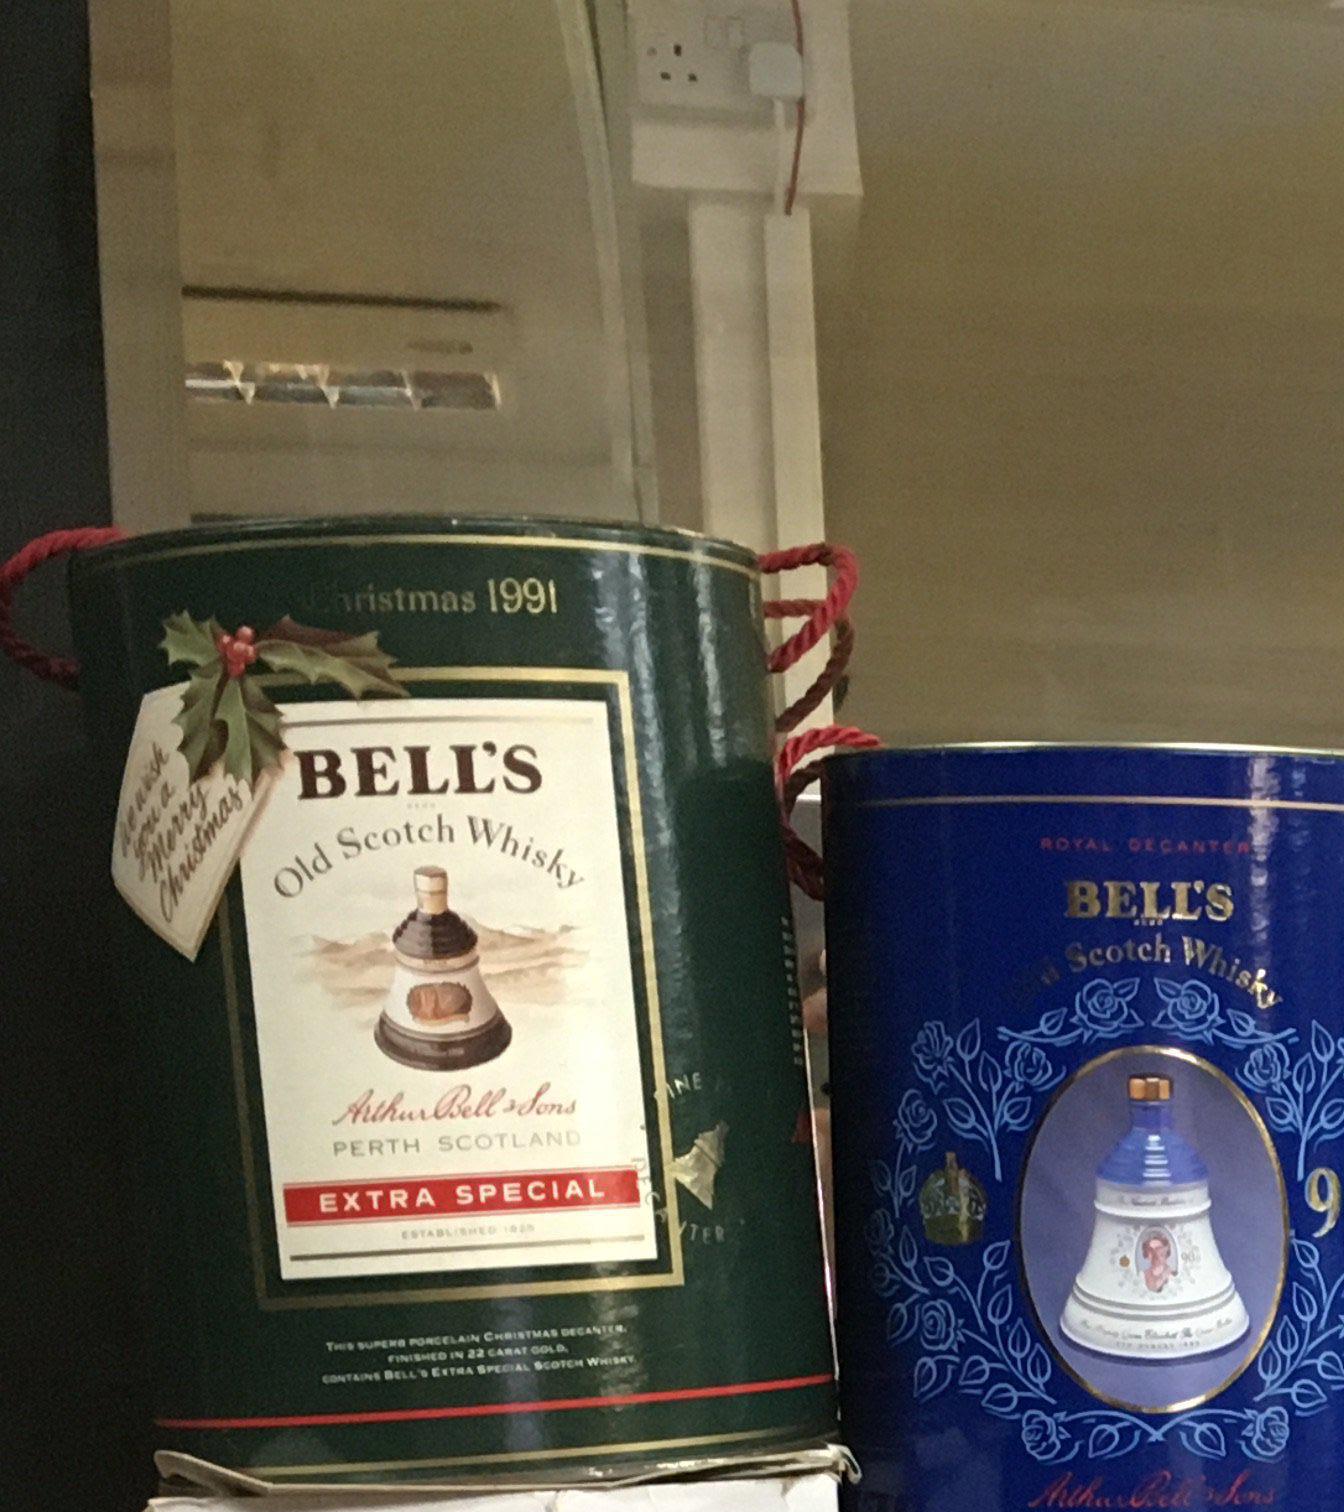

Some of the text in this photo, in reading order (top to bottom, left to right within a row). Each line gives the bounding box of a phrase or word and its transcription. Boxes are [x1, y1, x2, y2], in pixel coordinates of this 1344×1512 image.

[303, 578, 558, 614] ristmas 1991
[294, 741, 542, 801] BELL'S
[274, 813, 585, 898] Old Scotch Whisky
[1064, 879, 1234, 922] BELL'S
[1066, 932, 1282, 1009] Scotch Whisky
[333, 1129, 580, 1157] PERTH SCOTLAND
[320, 1179, 606, 1214] EXTRA SPECIAL
